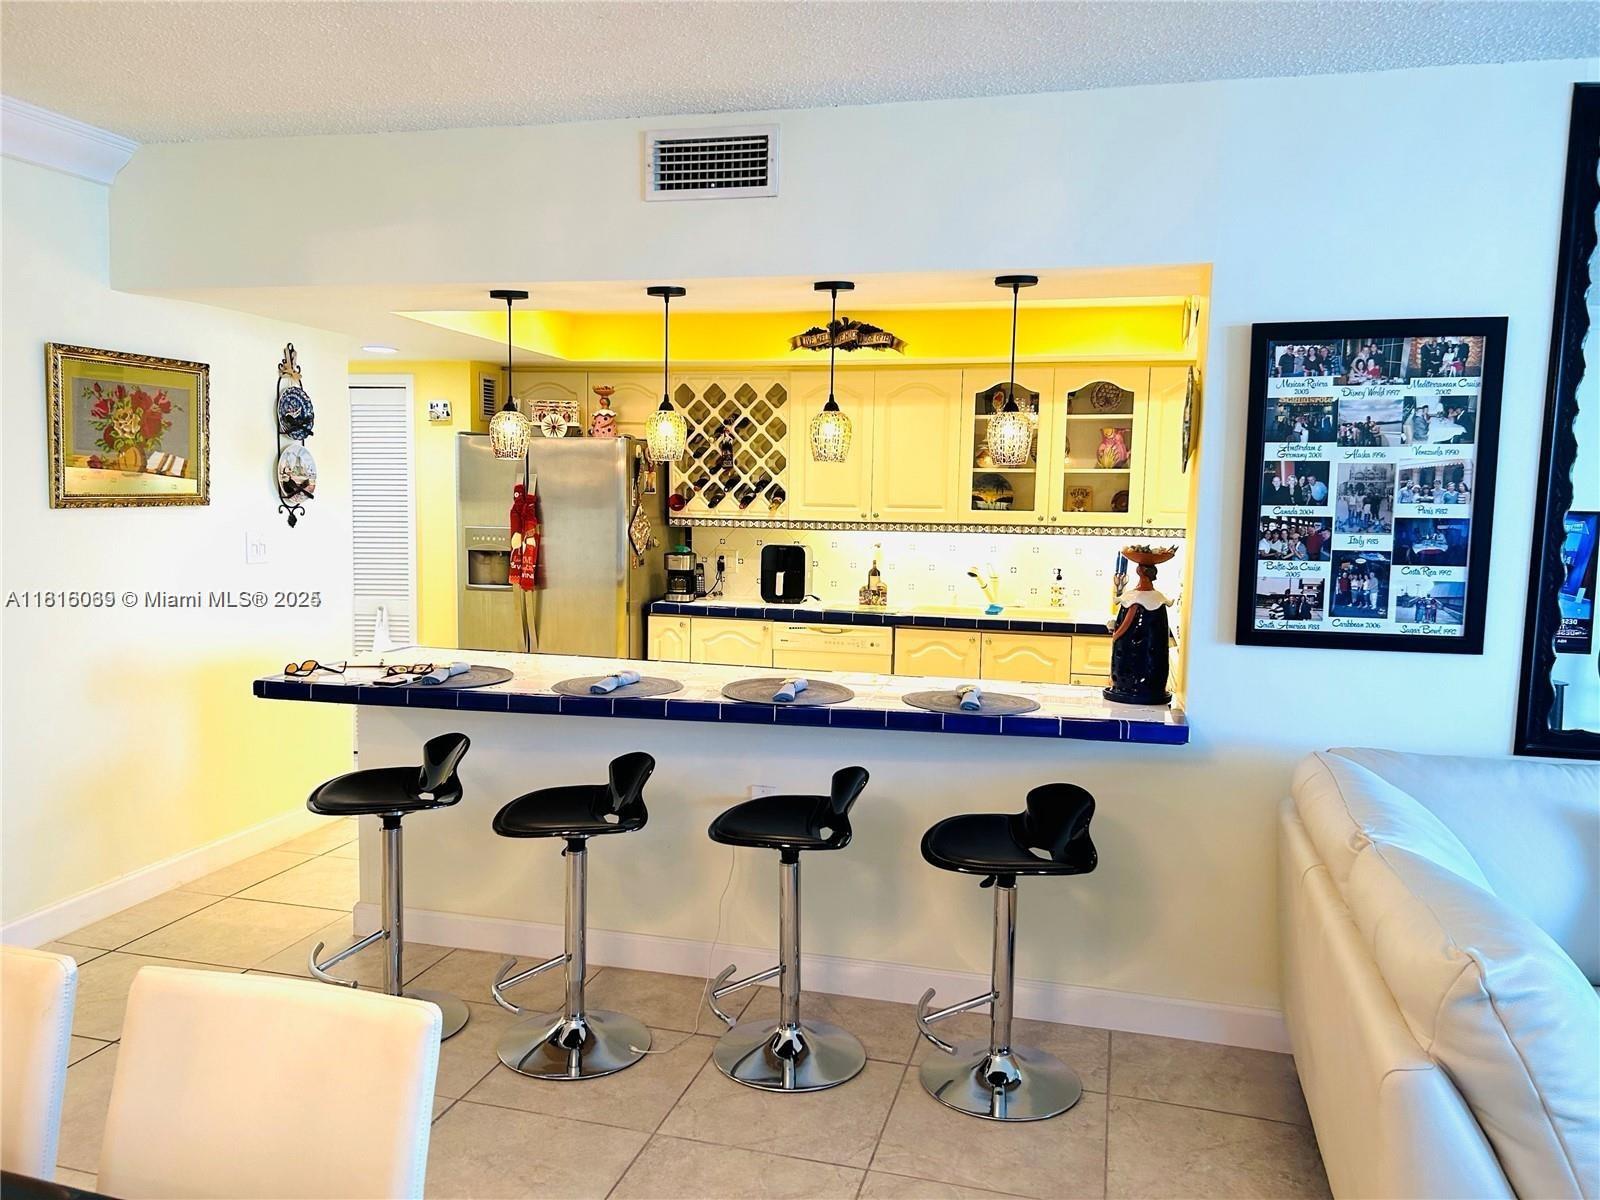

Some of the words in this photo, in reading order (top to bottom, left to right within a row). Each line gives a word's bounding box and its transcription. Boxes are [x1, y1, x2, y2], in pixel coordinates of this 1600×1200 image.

[1276, 379, 1305, 389] Mexican
[1407, 379, 1456, 389] Mediterranean
[1458, 378, 1480, 388] Cruise
[1341, 387, 1365, 399] Disney
[1366, 386, 1385, 396] World
[1277, 450, 1307, 460] Germany
[1344, 449, 1371, 459] Alaska
[1413, 446, 1443, 456] Venezuela
[1273, 507, 1298, 515] Canada
[1416, 505, 1434, 514] Paris
[1347, 535, 1364, 548] Italy
[1264, 561, 1286, 571] Baltic
[1286, 562, 1299, 571] Sea
[1299, 562, 1321, 571] Cruise
[1401, 566, 1420, 576] Costa
[1420, 566, 1437, 577] Rica
[1256, 619, 1275, 629] South
[1277, 620, 1306, 630] America
[1332, 618, 1364, 628] Caribbean
[1400, 624, 1420, 635] Sugar
[1420, 624, 1442, 634] Bowl
